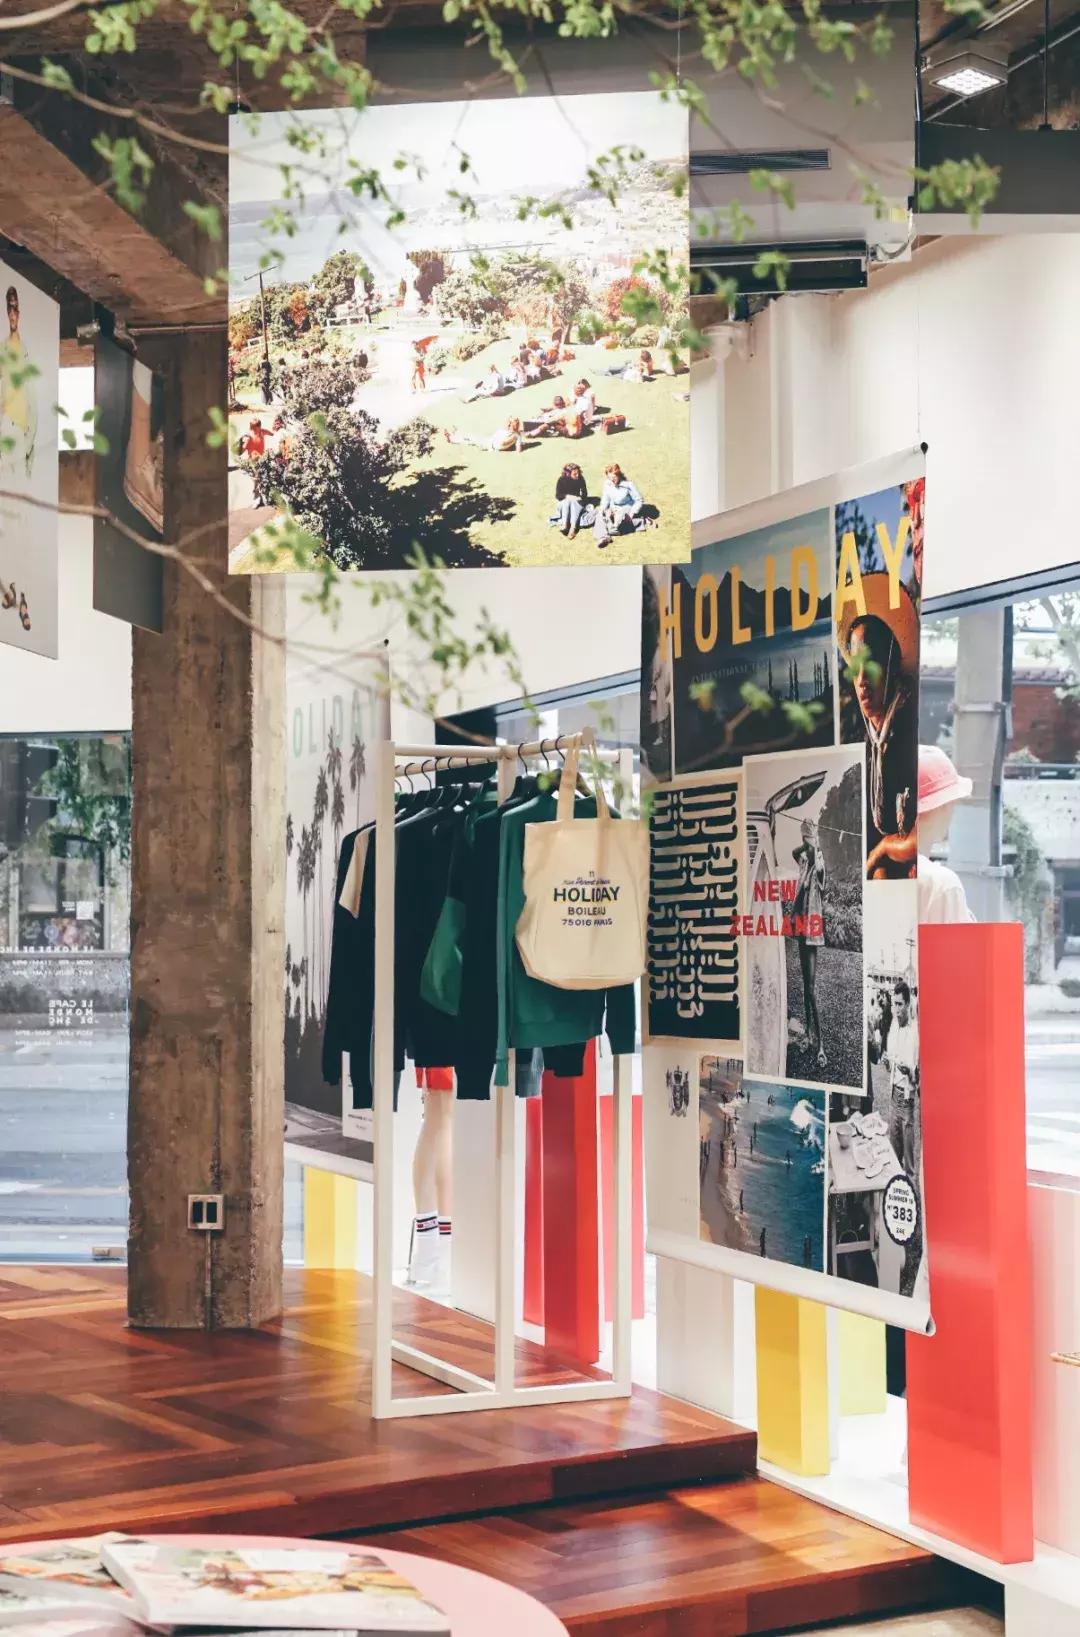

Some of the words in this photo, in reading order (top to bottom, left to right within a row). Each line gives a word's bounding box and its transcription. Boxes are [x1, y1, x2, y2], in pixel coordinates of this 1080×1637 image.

[658, 516, 911, 661] HOLIDAY
[553, 886, 620, 902] HOLIDAY
[753, 880, 798, 902] NEW
[562, 918, 592, 926] 75016
[729, 914, 824, 937] ZEALAND
[888, 1194, 908, 1203] SUMMER
[893, 1187, 909, 1195] SPRING
